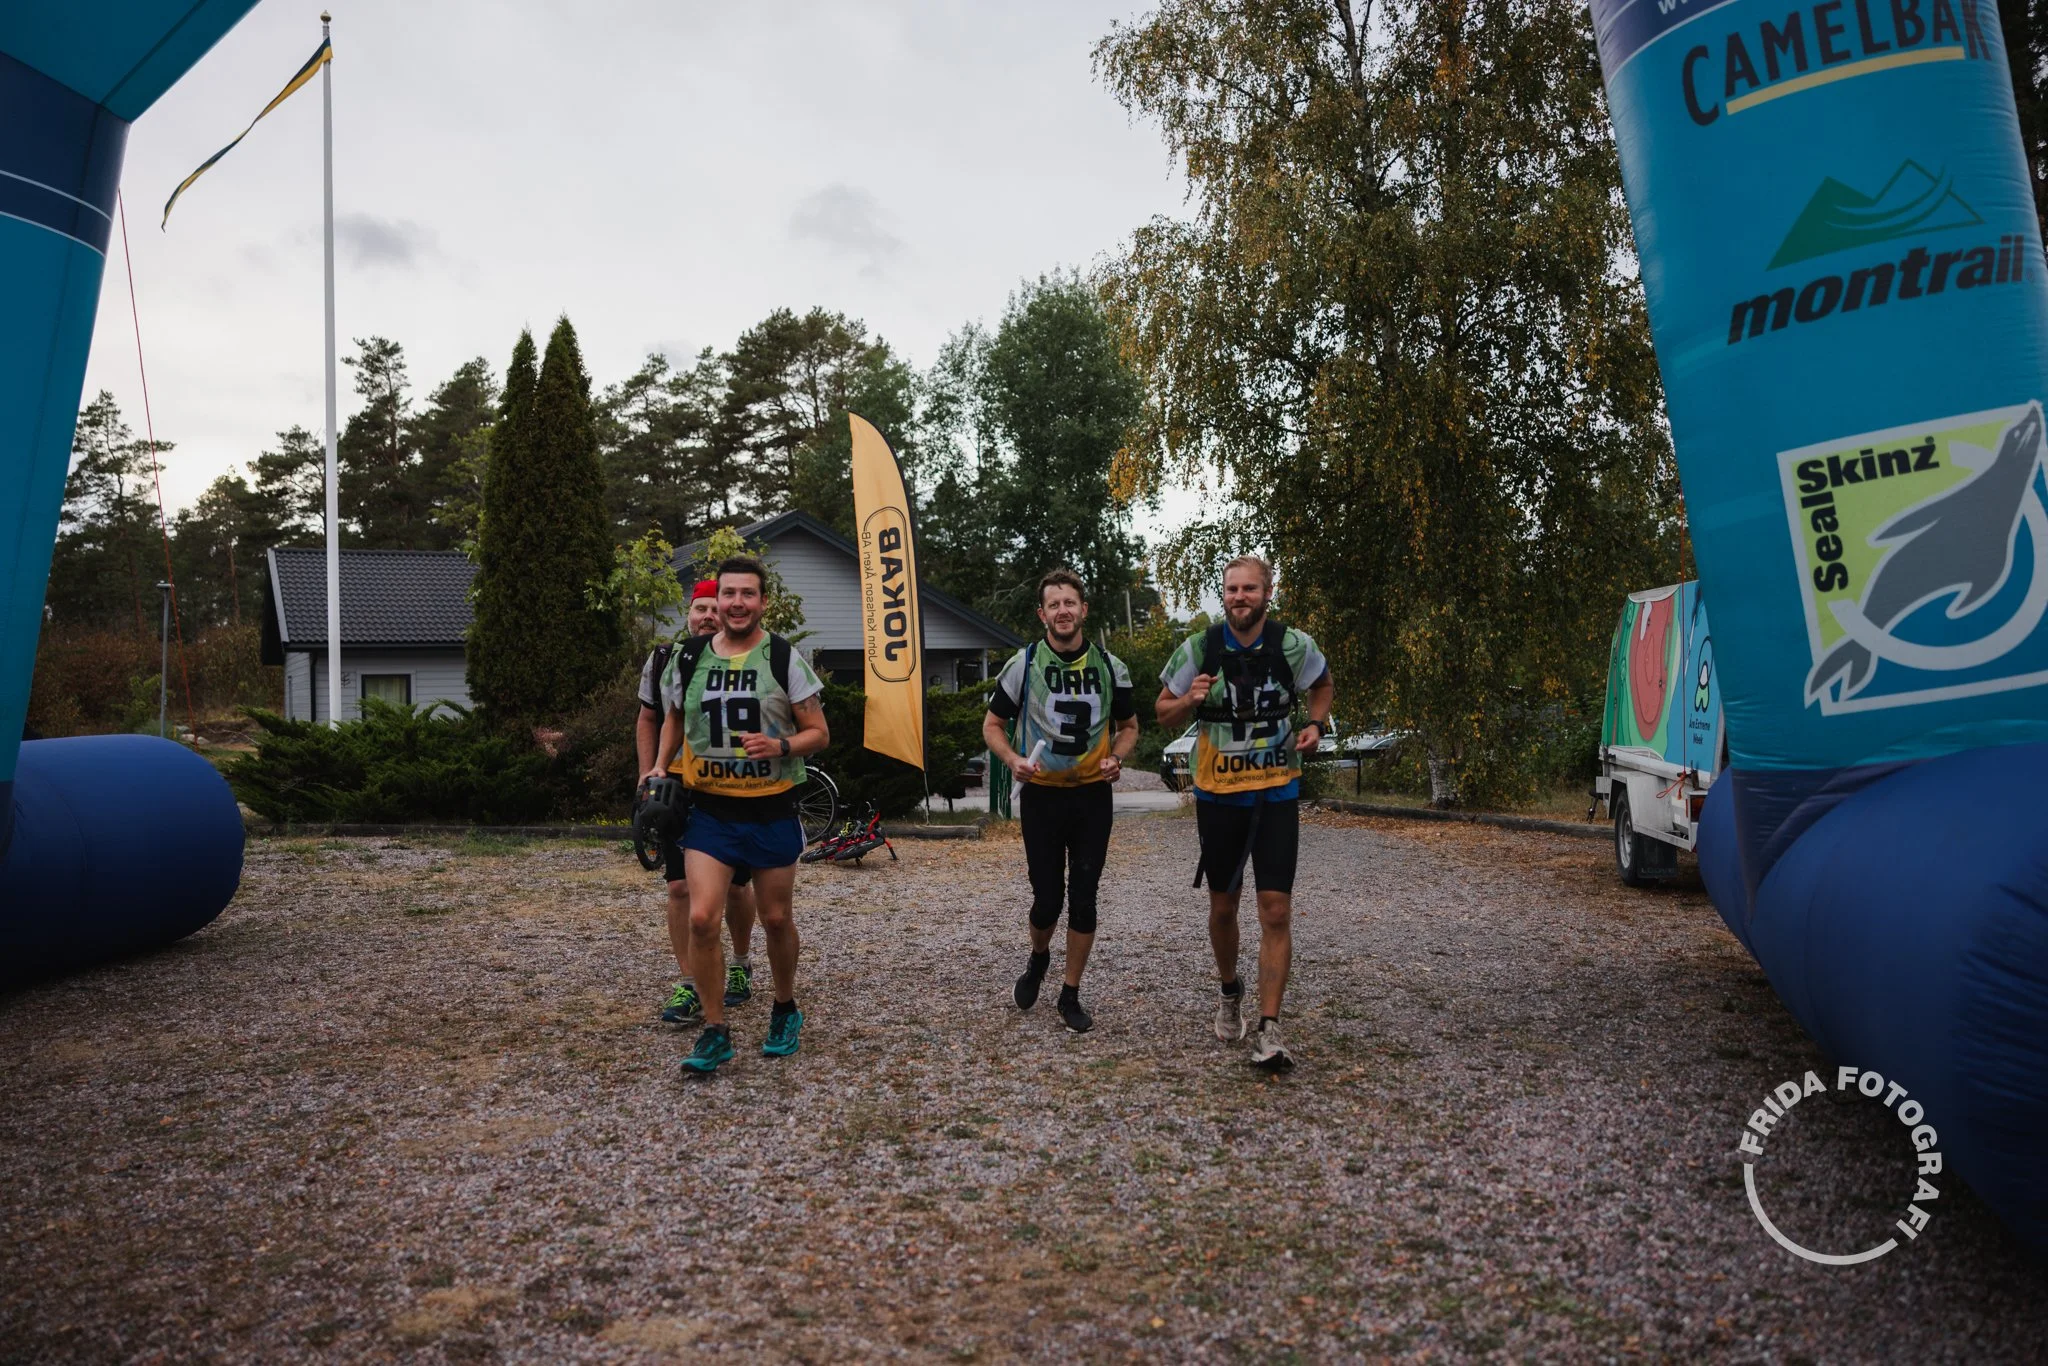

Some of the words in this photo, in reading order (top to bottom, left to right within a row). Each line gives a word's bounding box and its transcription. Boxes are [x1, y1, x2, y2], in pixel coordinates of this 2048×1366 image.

[1681, 0, 1993, 127] CAMELBAK
[1727, 235, 2024, 346] montrail
[1800, 491, 1849, 593] Seal
[705, 665, 758, 692] ÖAR
[701, 697, 761, 749] 19
[1050, 700, 1092, 756] 3
[698, 760, 772, 779] JOKAB
[1217, 750, 1288, 773] JOKAB
